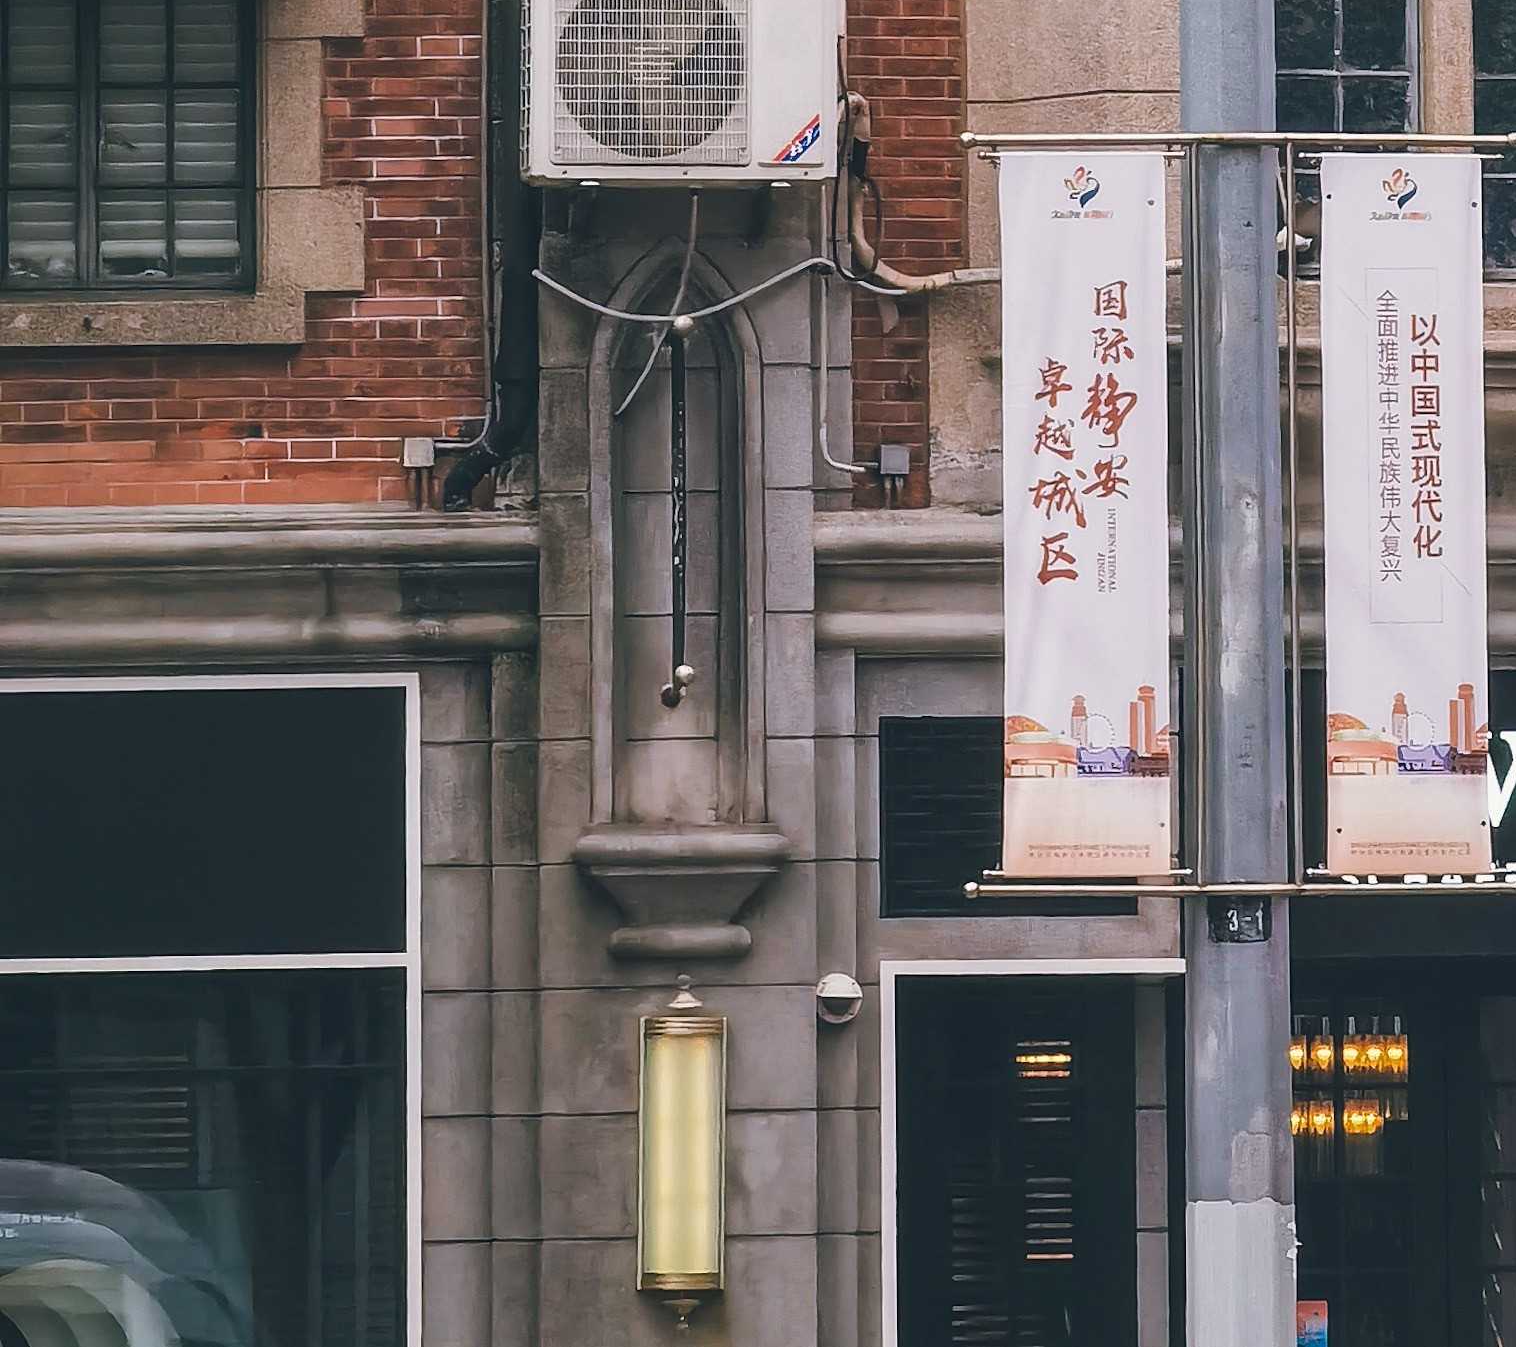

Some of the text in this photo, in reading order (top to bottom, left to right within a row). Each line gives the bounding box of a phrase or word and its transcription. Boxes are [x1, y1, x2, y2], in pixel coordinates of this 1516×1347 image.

[1028, 357, 1087, 586] 卓越城区
[1081, 280, 1138, 499] 国际静安
[1376, 289, 1402, 583] 全面推进中华民族伟大复兴
[1410, 313, 1443, 560] 以中国式现代化
